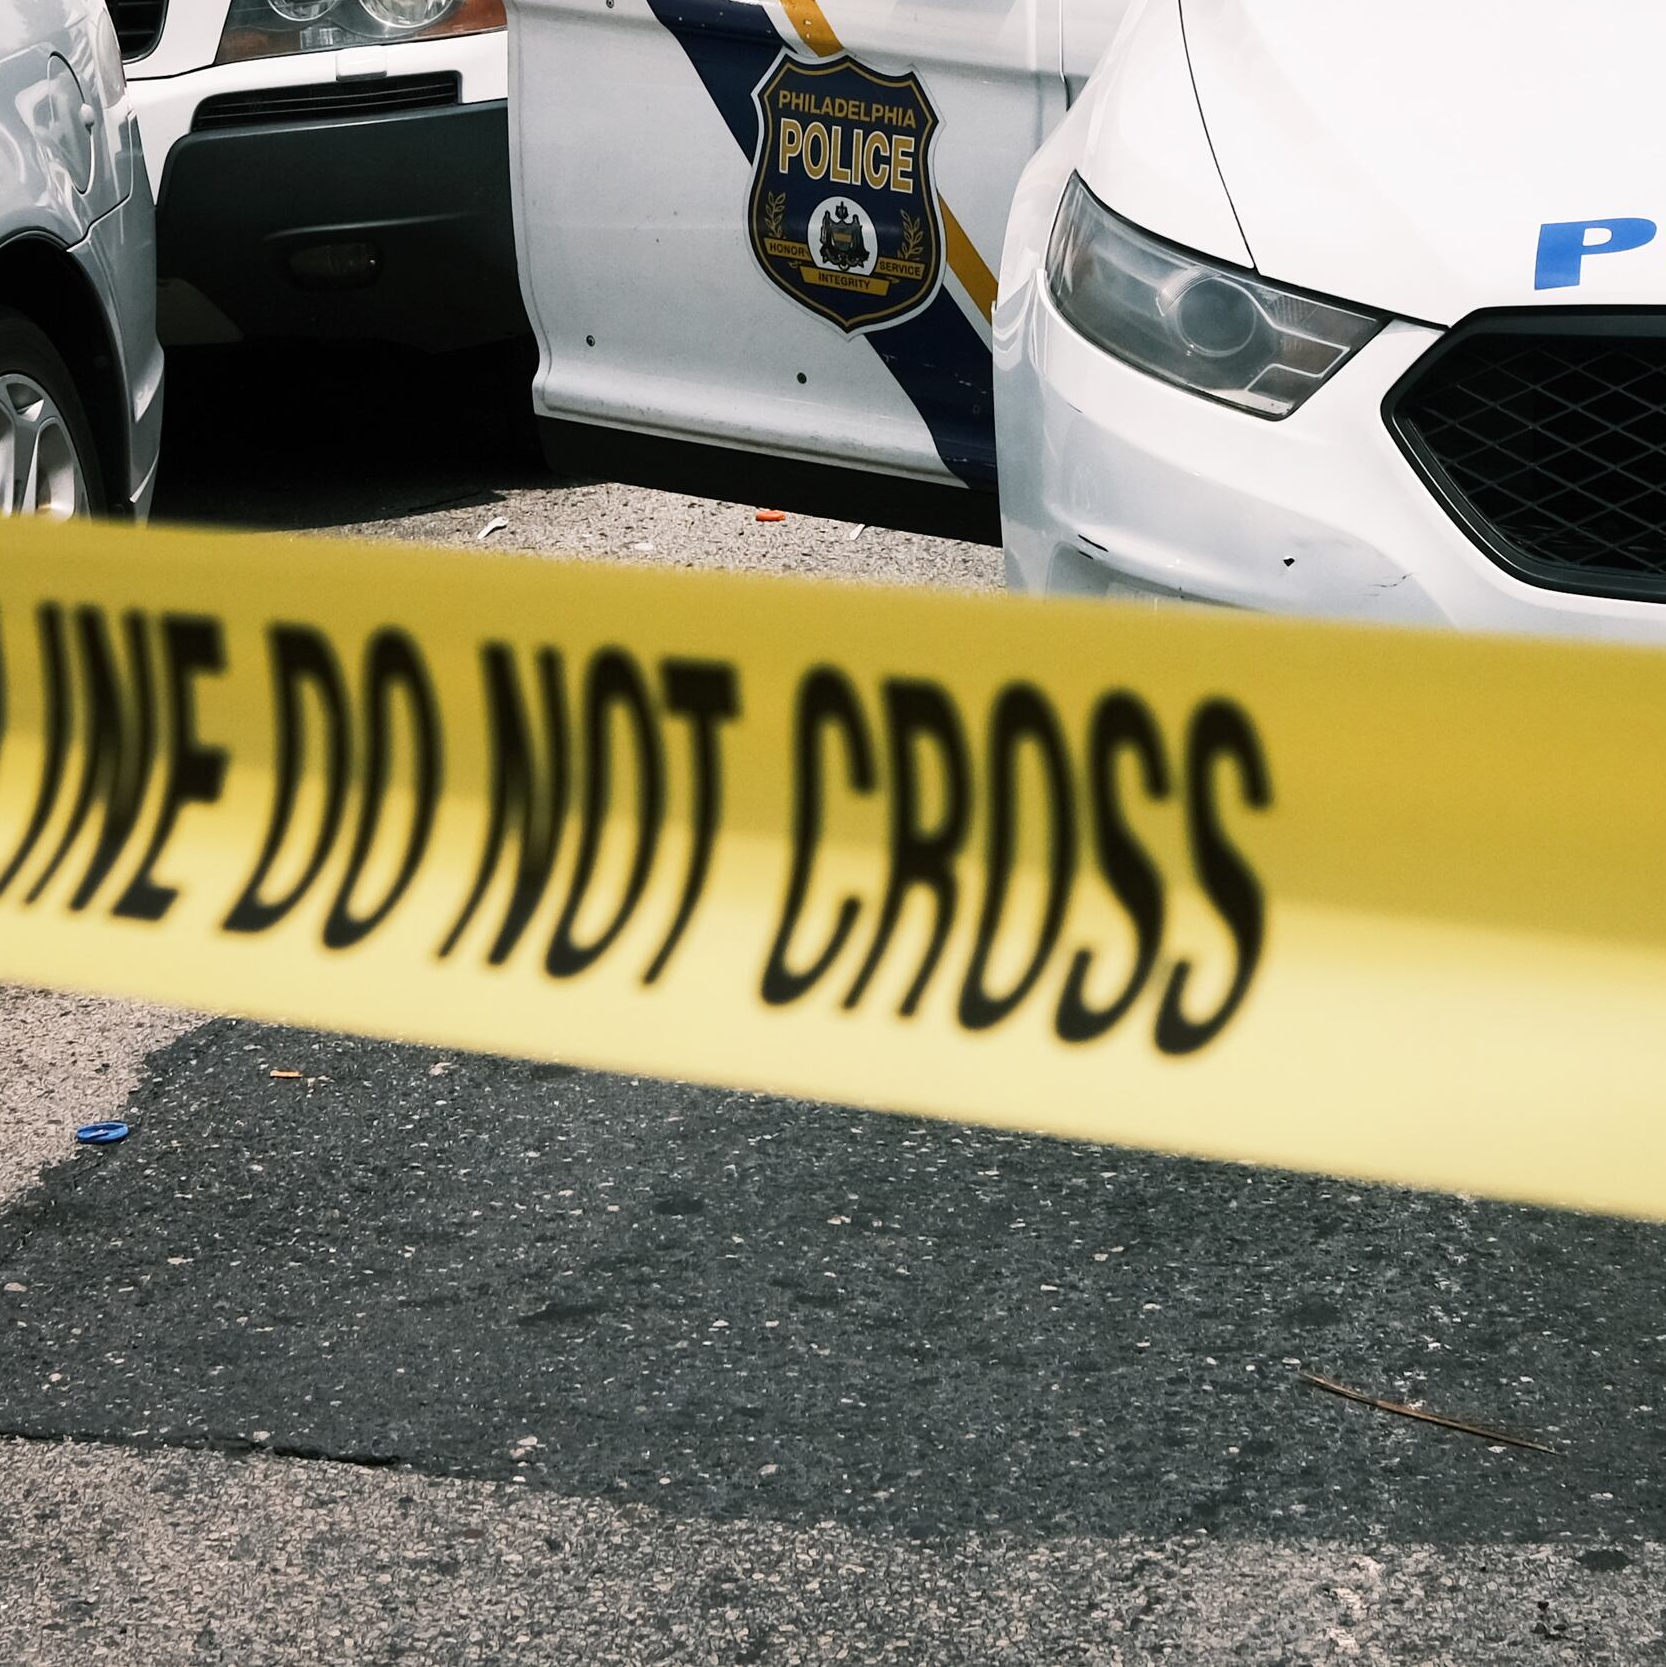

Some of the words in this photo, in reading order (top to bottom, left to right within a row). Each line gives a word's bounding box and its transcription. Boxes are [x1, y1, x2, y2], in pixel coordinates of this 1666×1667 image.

[778, 90, 916, 129] PHILADELPHIA
[778, 117, 915, 194] POLICE
[769, 243, 806, 258] HONOR
[879, 260, 922, 277] SERVICE
[818, 271, 871, 290] INTEGRITY
[221, 618, 447, 951] DO
[435, 638, 744, 989] NOT
[759, 662, 1275, 1056] CROSS
